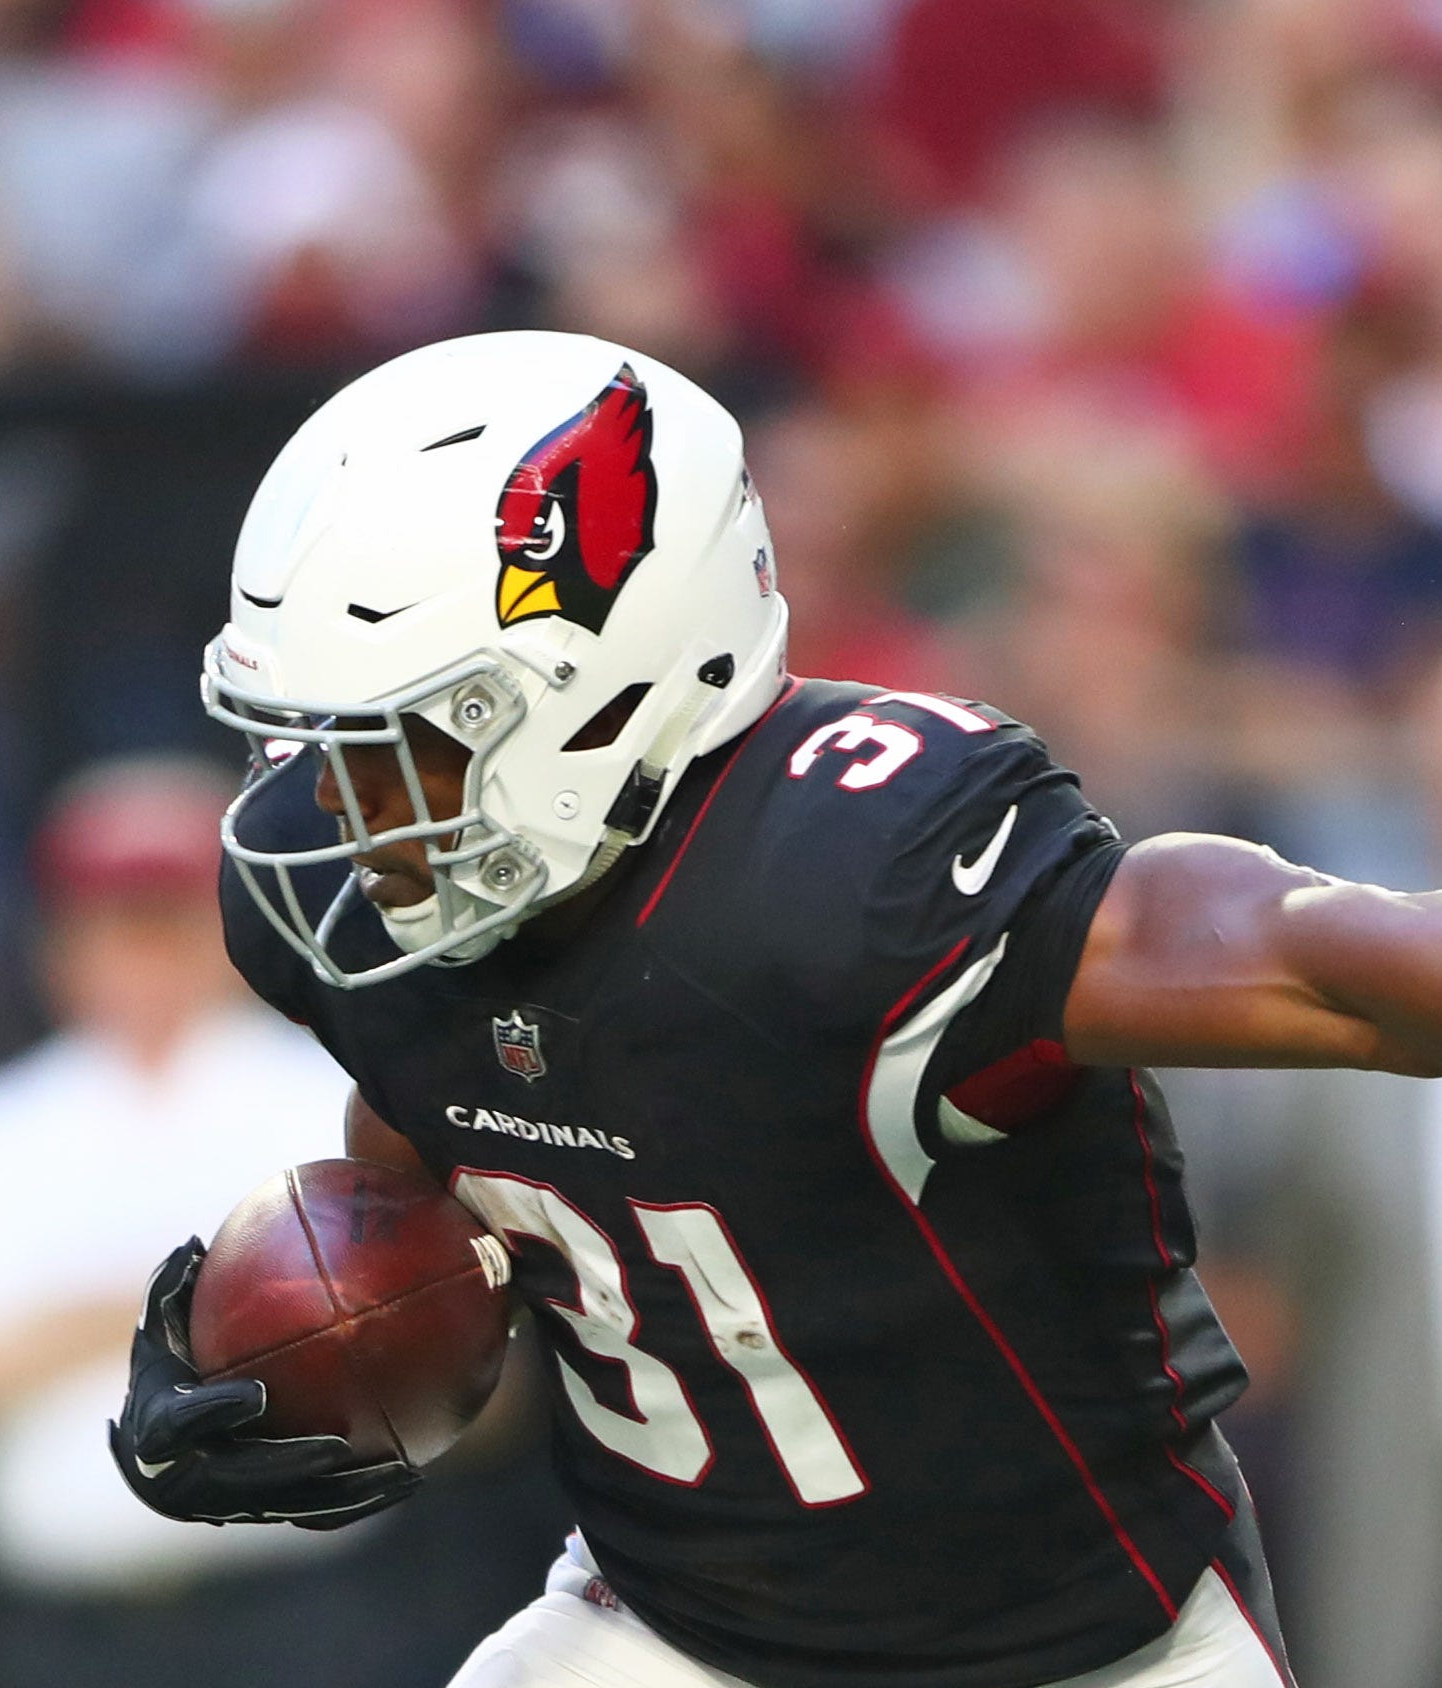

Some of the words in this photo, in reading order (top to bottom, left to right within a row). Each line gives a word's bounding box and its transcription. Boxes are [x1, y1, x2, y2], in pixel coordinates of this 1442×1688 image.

[786, 690, 998, 792] 31
[445, 1105, 636, 1160] CARDINALS
[449, 1164, 872, 1509] 31
